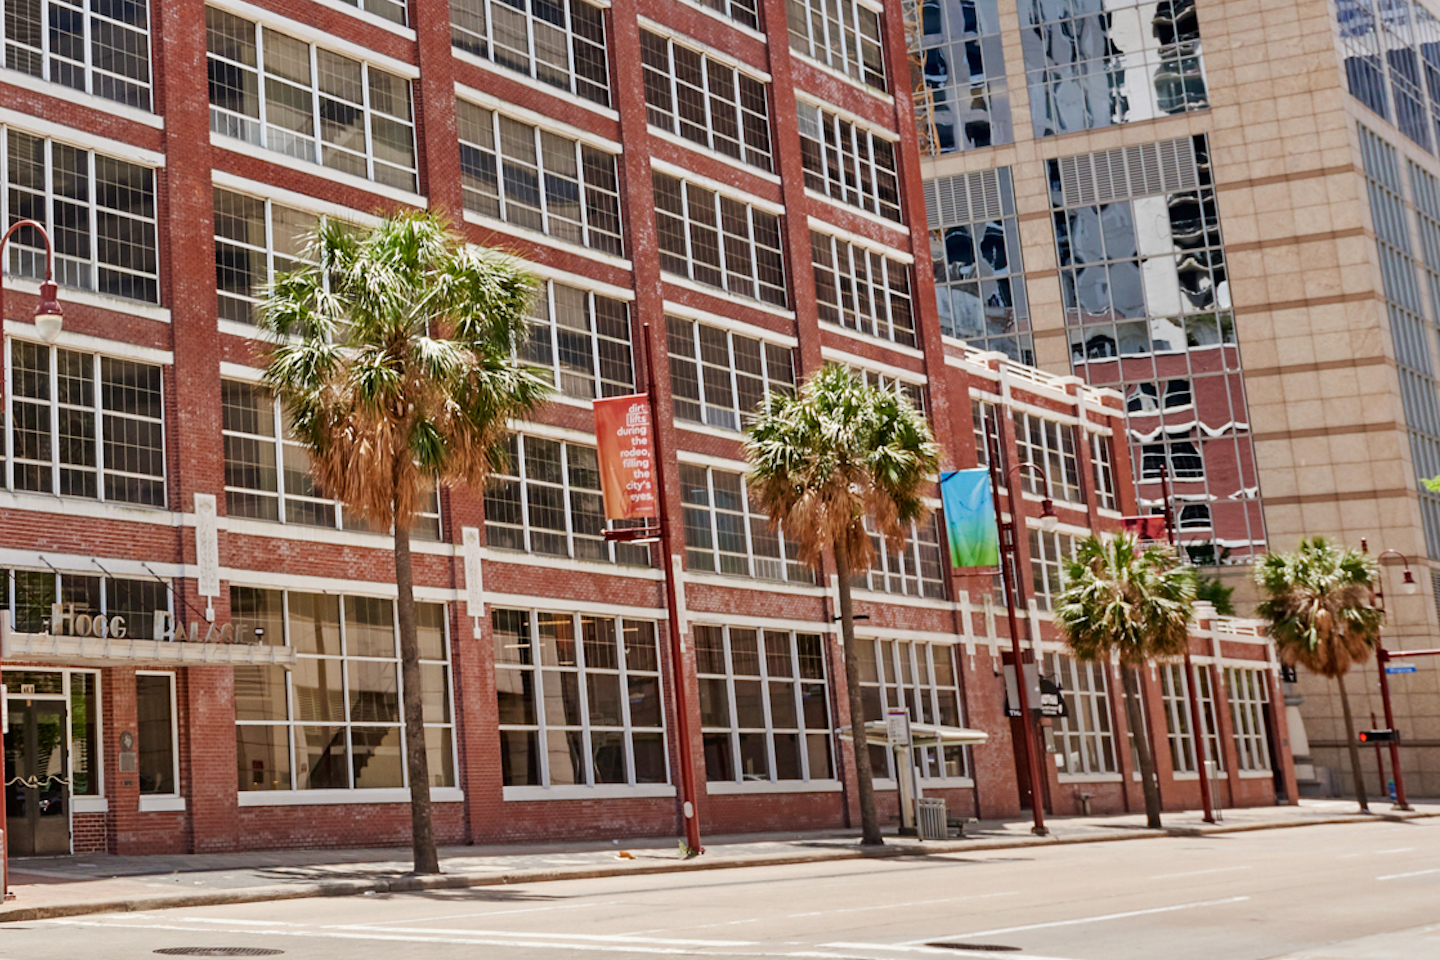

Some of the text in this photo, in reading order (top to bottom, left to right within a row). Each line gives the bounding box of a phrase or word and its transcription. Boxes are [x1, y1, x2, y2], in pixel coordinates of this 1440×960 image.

[616, 426, 647, 437] during
[631, 436, 648, 445] the
[620, 447, 651, 458] rodeo,
[622, 458, 649, 469] filling
[633, 469, 650, 479] the
[626, 480, 652, 491] city's
[630, 492, 654, 502] eyes.
